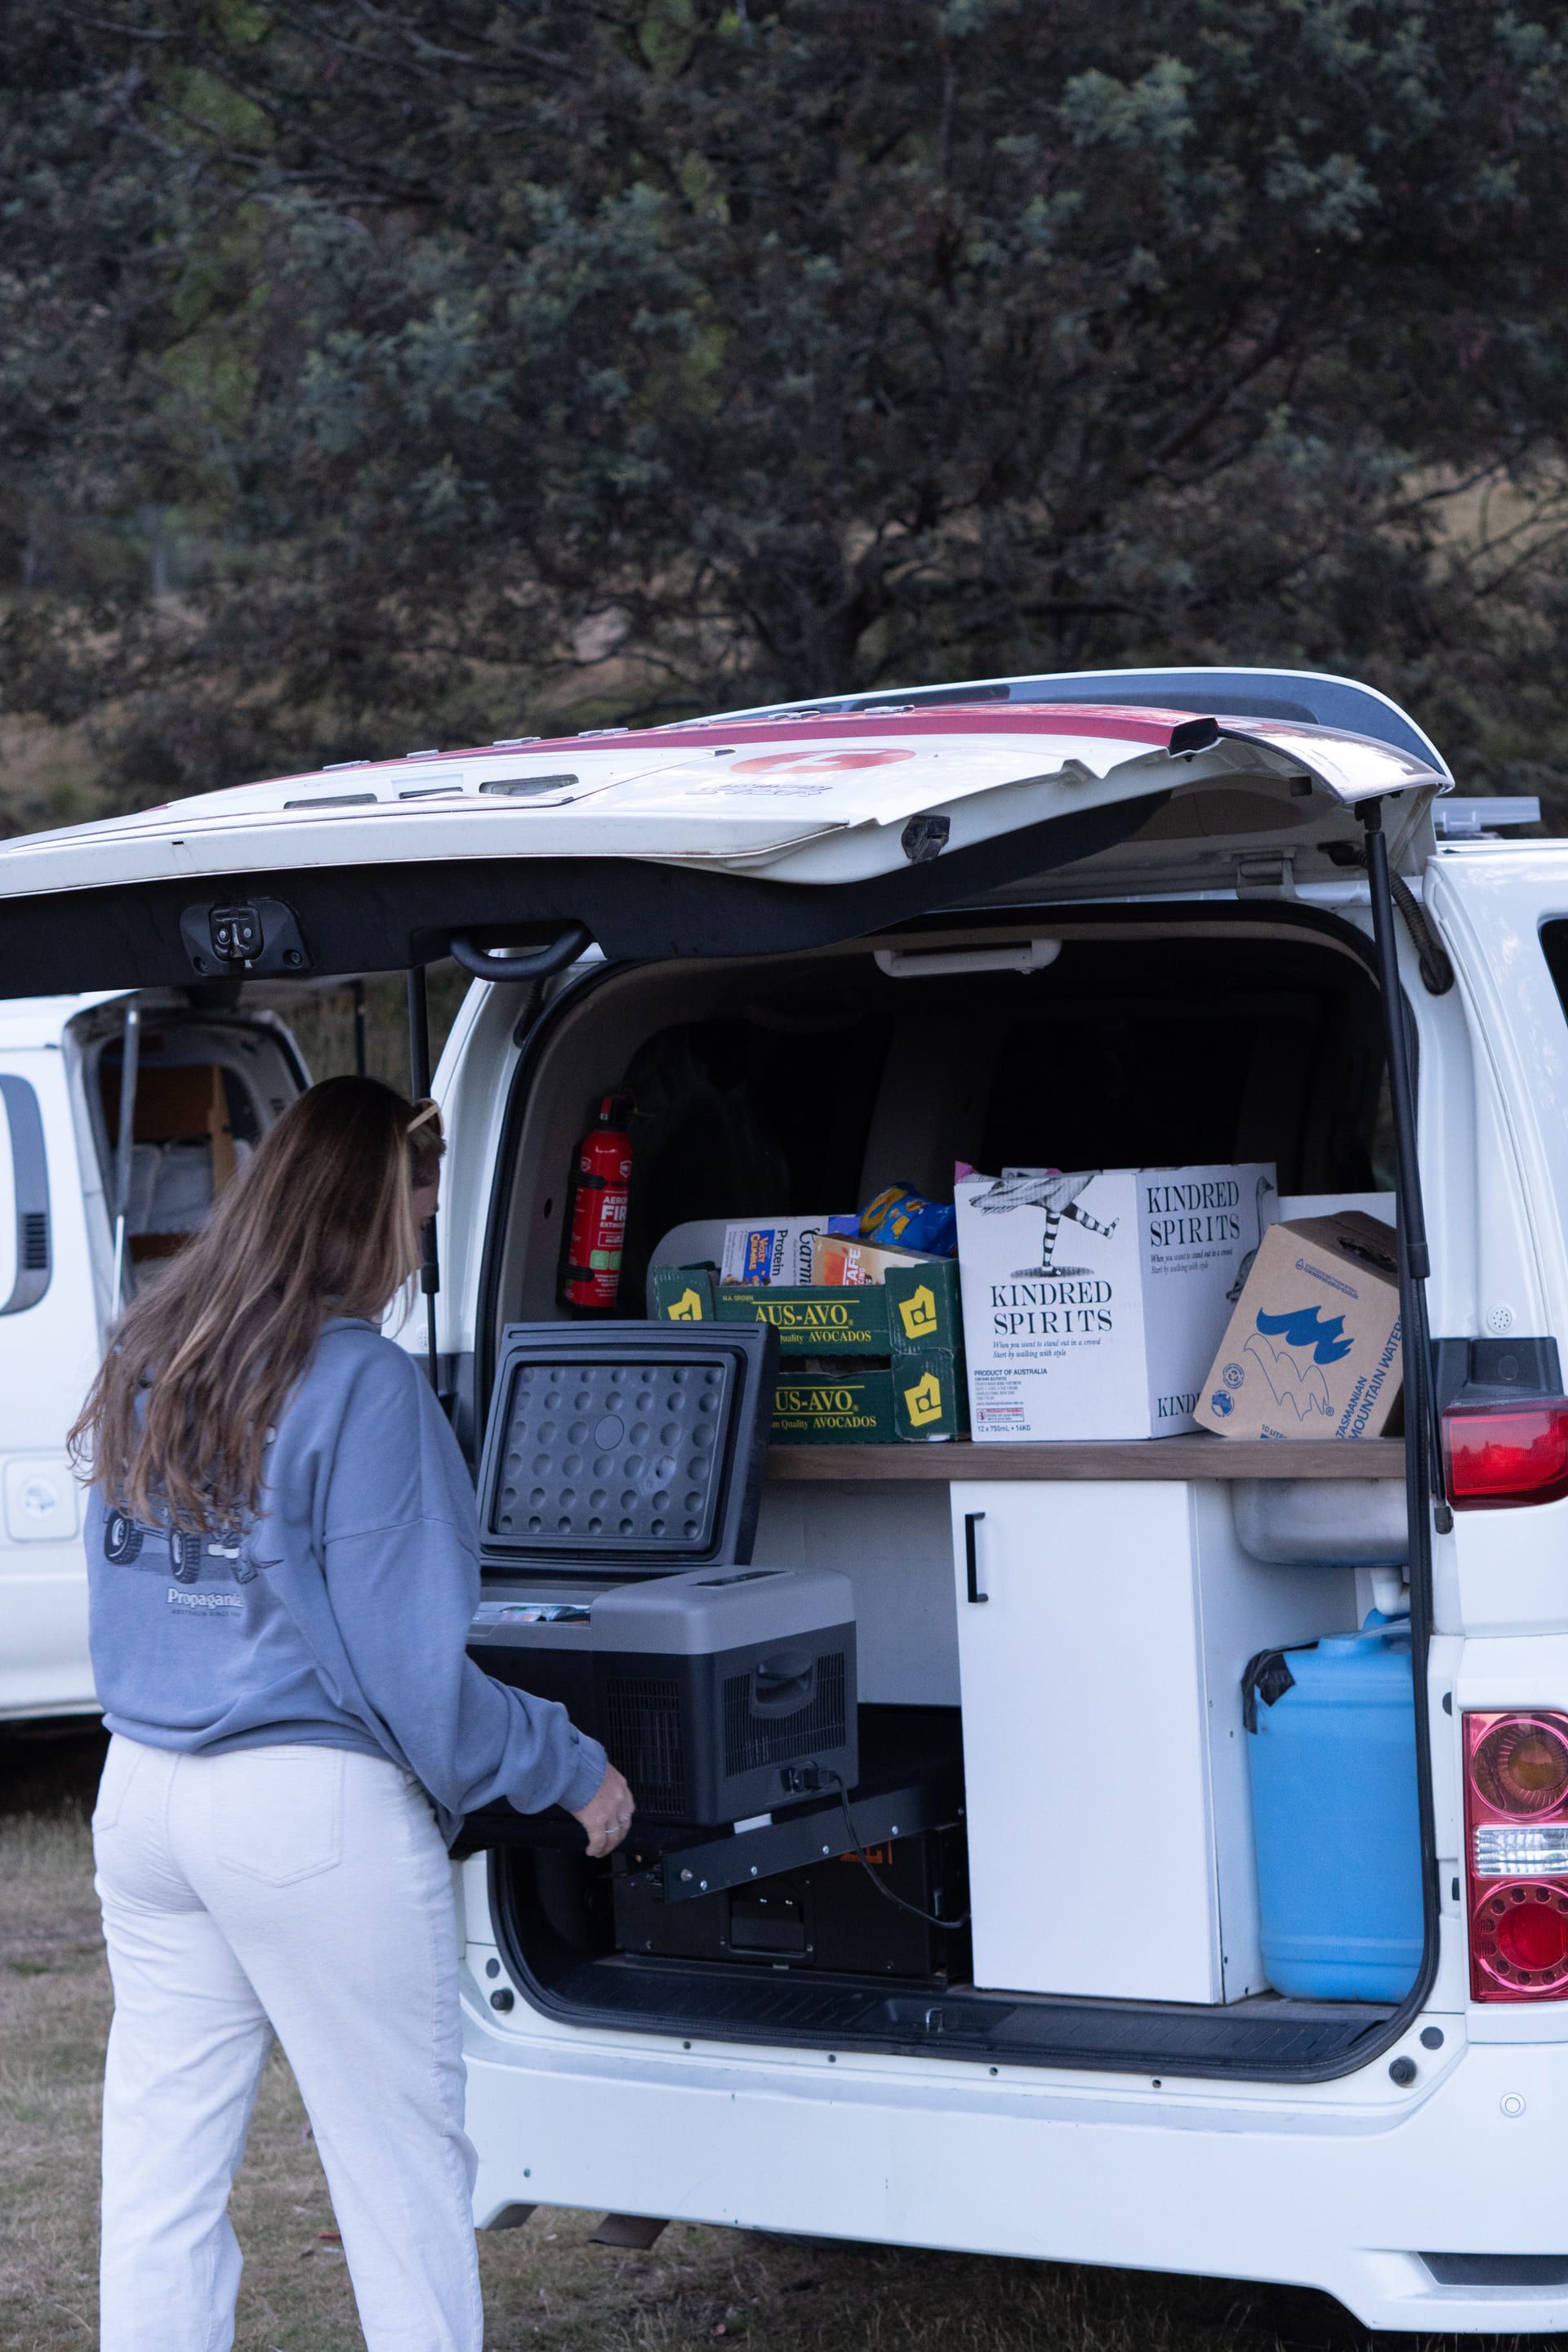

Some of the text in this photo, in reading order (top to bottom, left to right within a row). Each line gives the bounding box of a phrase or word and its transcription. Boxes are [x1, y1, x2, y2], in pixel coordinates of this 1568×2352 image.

[1146, 1180, 1240, 1214] KINDRED
[601, 1205, 627, 1222] FIR
[1150, 1214, 1241, 1247] SPIRITS
[772, 1228, 788, 1276] Protein
[799, 1227, 820, 1285] Carm
[990, 1280, 1112, 1307] KINDRED
[755, 1304, 848, 1325] AUS-AVO
[993, 1308, 1112, 1335] SPIRITS
[808, 1330, 871, 1343] AVOCADOS
[993, 1340, 1009, 1348] When
[1010, 1341, 1020, 1351] you
[1044, 1339, 1059, 1347] stand
[1084, 1337, 1101, 1345] crowd
[993, 1350, 1007, 1358] Start
[1008, 1350, 1014, 1359] by
[1015, 1350, 1038, 1359] walking
[1054, 1348, 1067, 1358] style
[774, 1390, 853, 1411] US-AVO
[1157, 1392, 1200, 1418] KIND
[1335, 1375, 1367, 1437] TASMANIAN
[1348, 1368, 1387, 1438] MOUNTAIN
[782, 1419, 808, 1430] Quality
[813, 1415, 876, 1428] AVOCADOS
